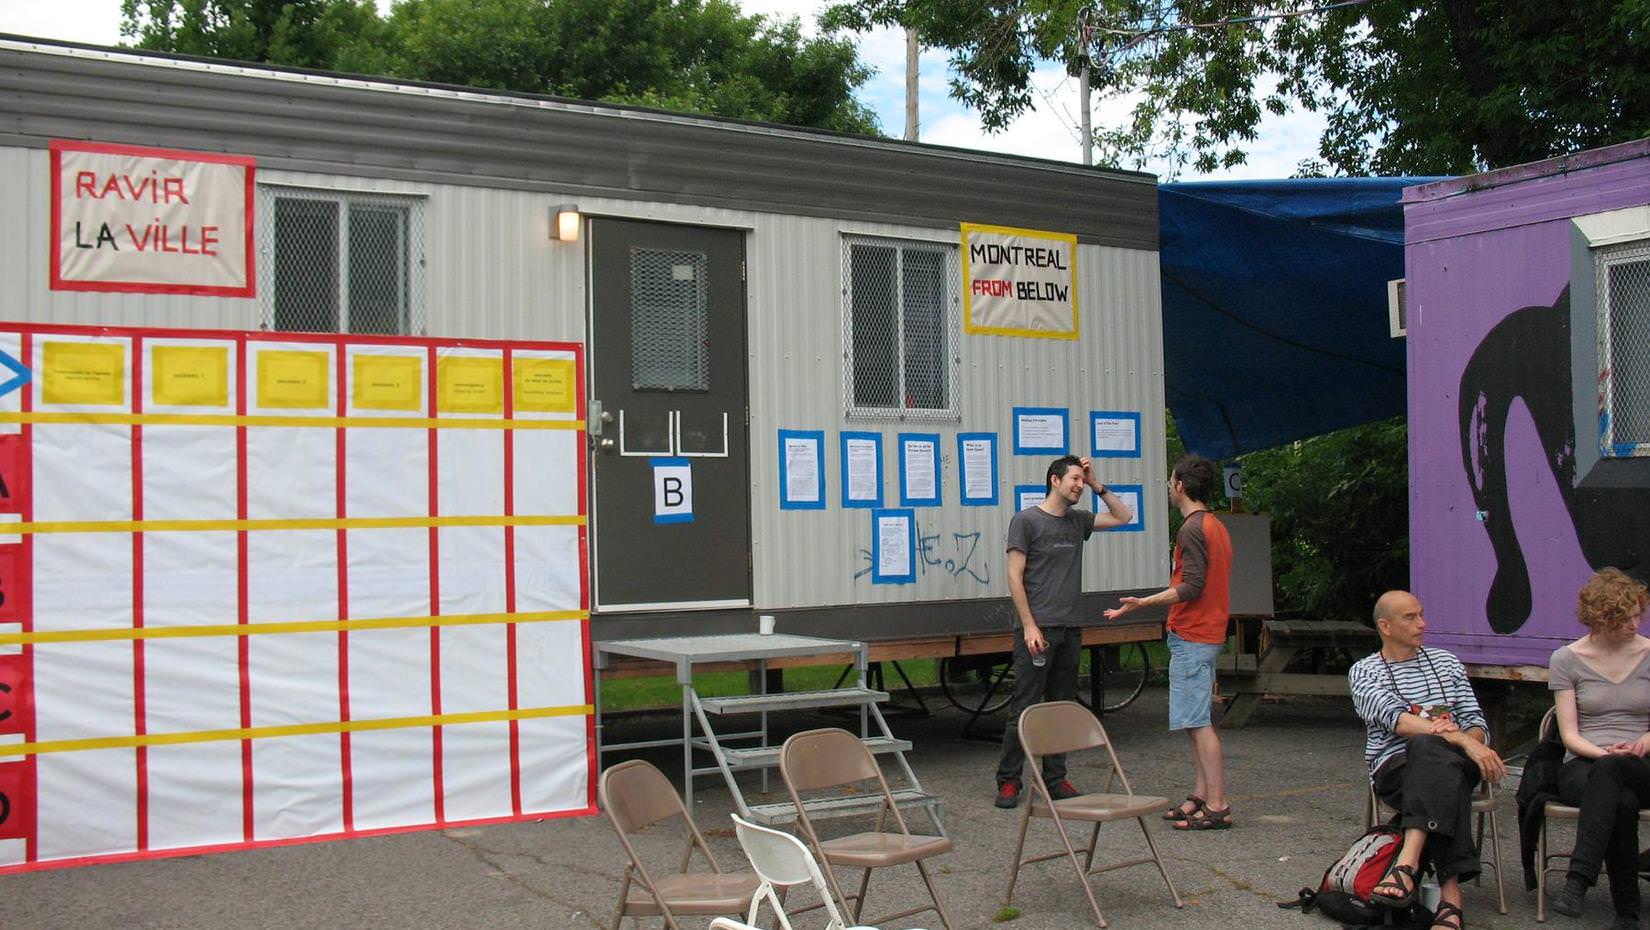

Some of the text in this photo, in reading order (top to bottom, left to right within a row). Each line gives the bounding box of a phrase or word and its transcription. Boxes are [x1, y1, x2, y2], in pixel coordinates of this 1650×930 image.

[76, 221, 119, 251] LA
[971, 244, 1067, 271] MONTREAL
[972, 279, 1068, 302] FROM BELOW
[664, 477, 684, 507] B
